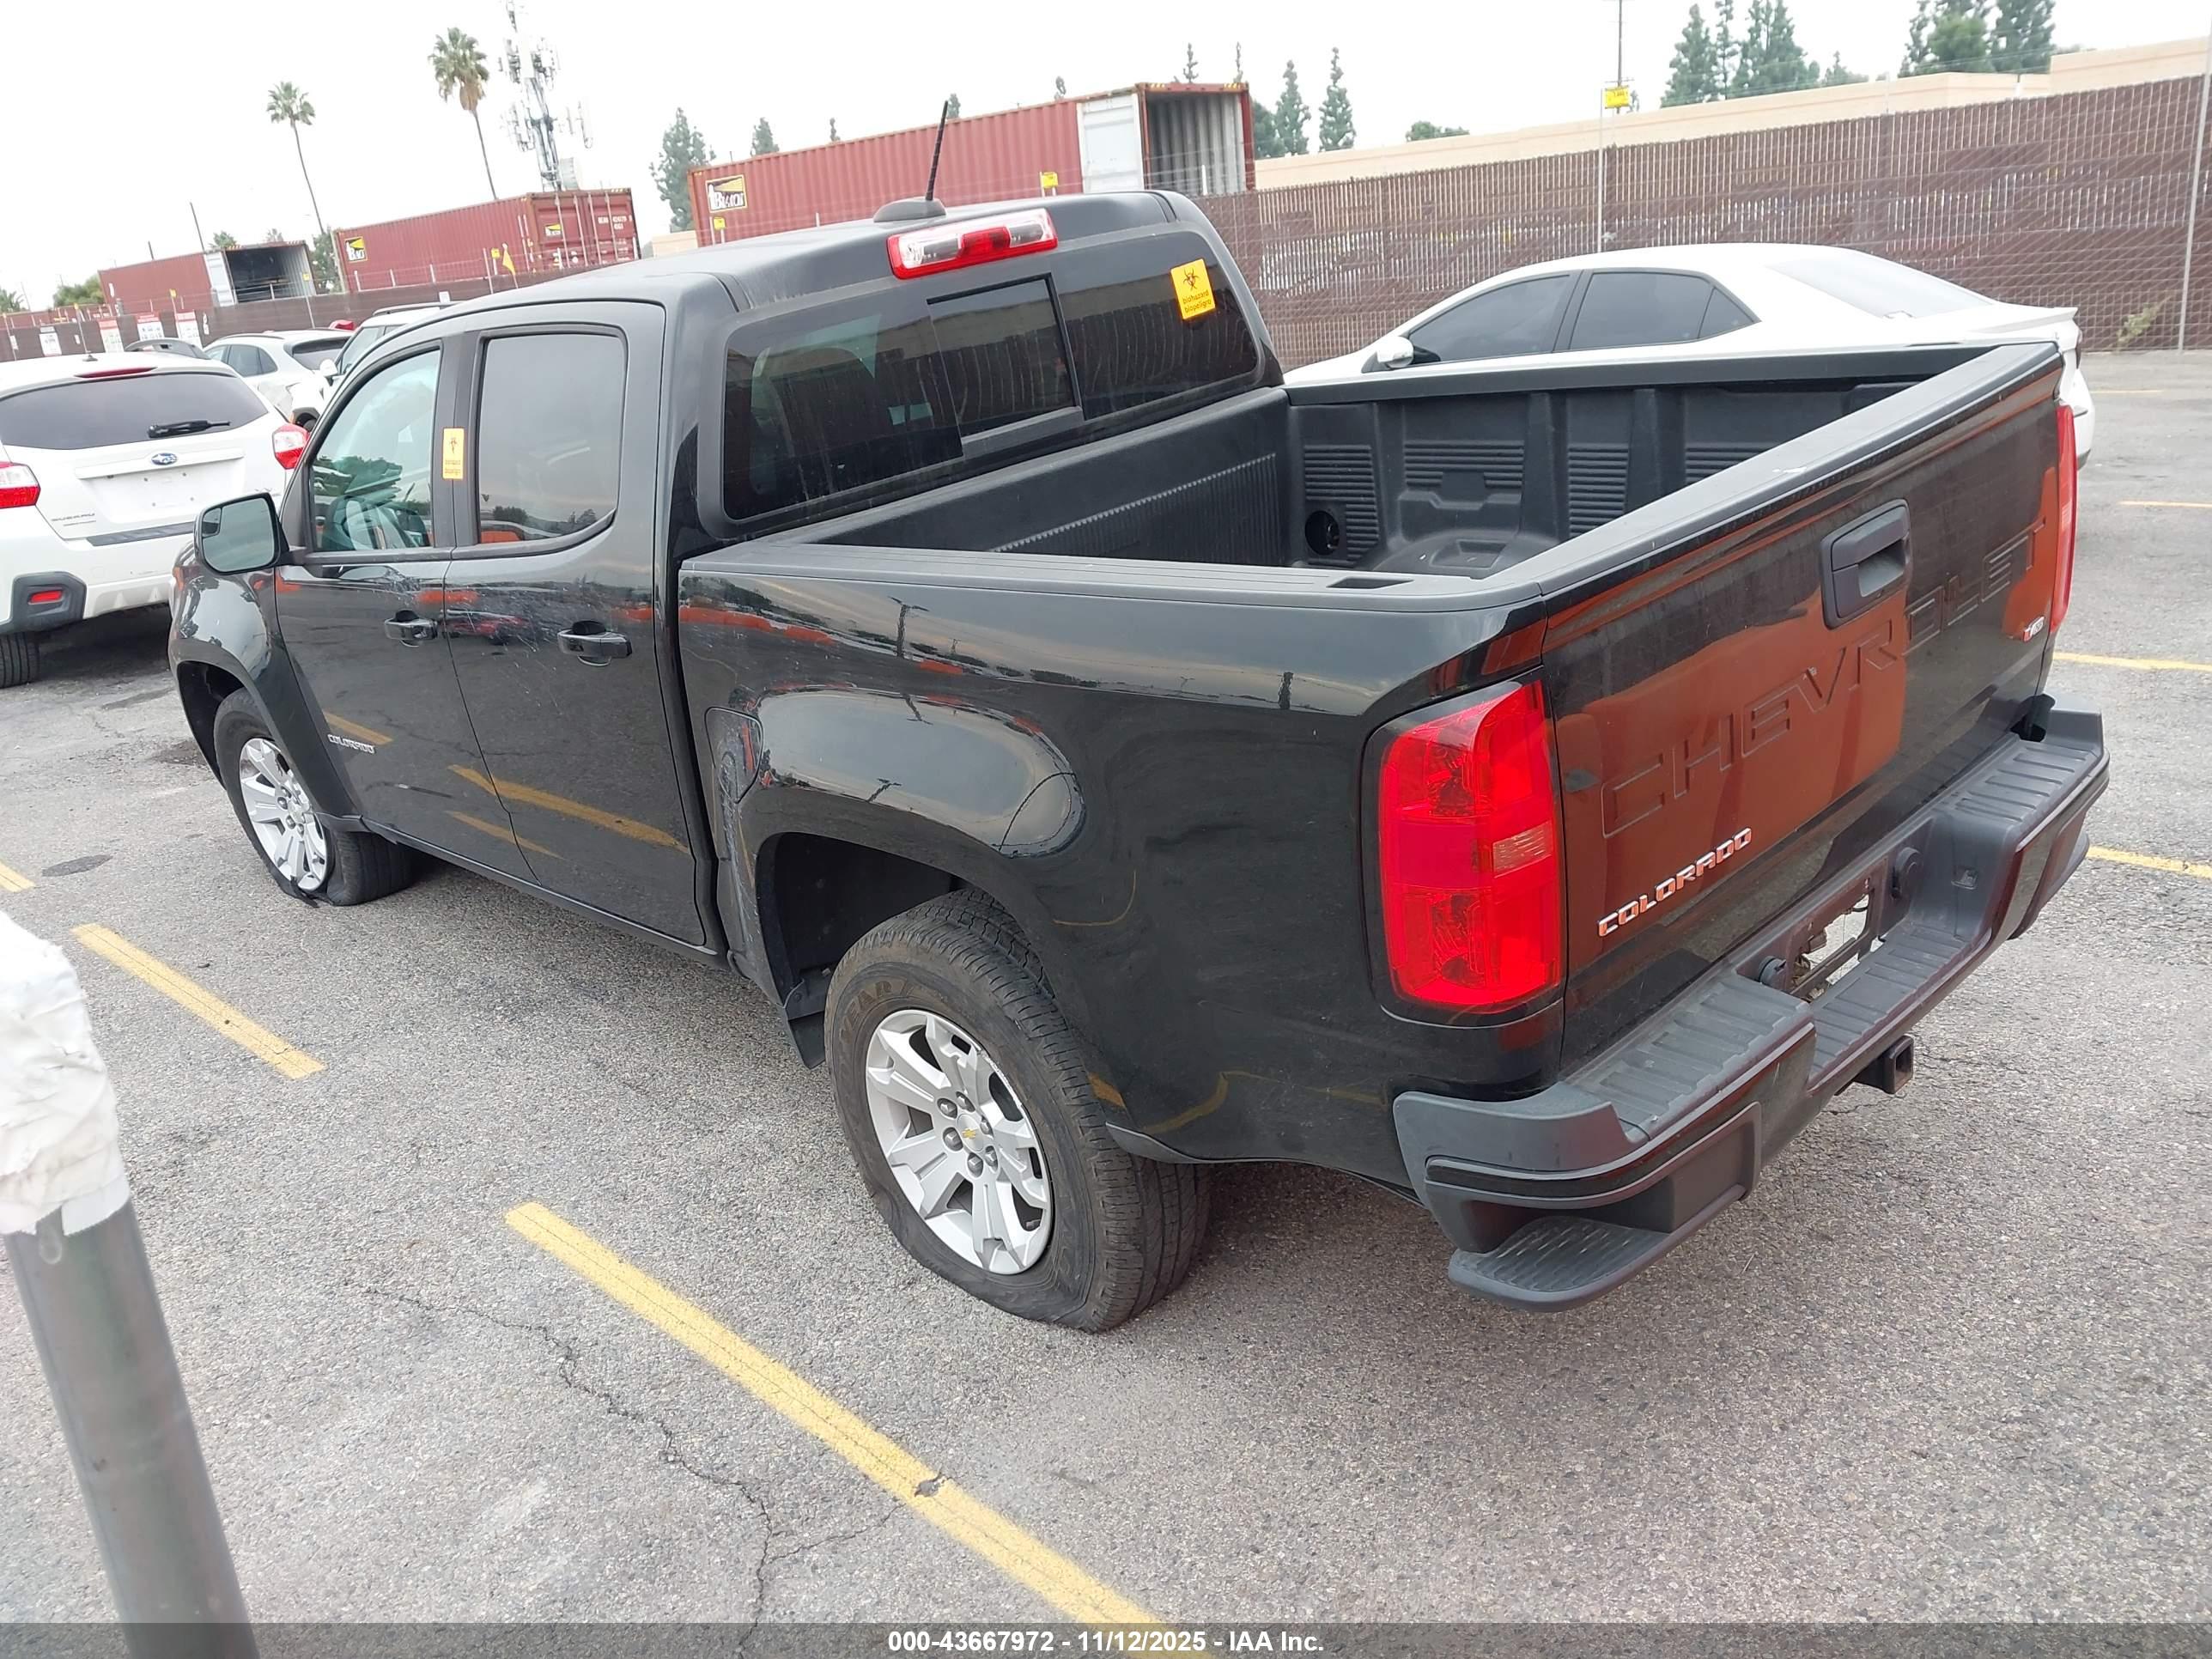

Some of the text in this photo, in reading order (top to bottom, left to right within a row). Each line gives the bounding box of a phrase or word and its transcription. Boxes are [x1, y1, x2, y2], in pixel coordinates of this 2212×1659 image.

[1182, 290, 1209, 304] biohazard
[1185, 299, 1212, 313] biopeligro
[1600, 517, 2048, 839] CHEVROLET
[327, 733, 375, 754] COLORADO
[1598, 827, 1752, 937] COLORADO
